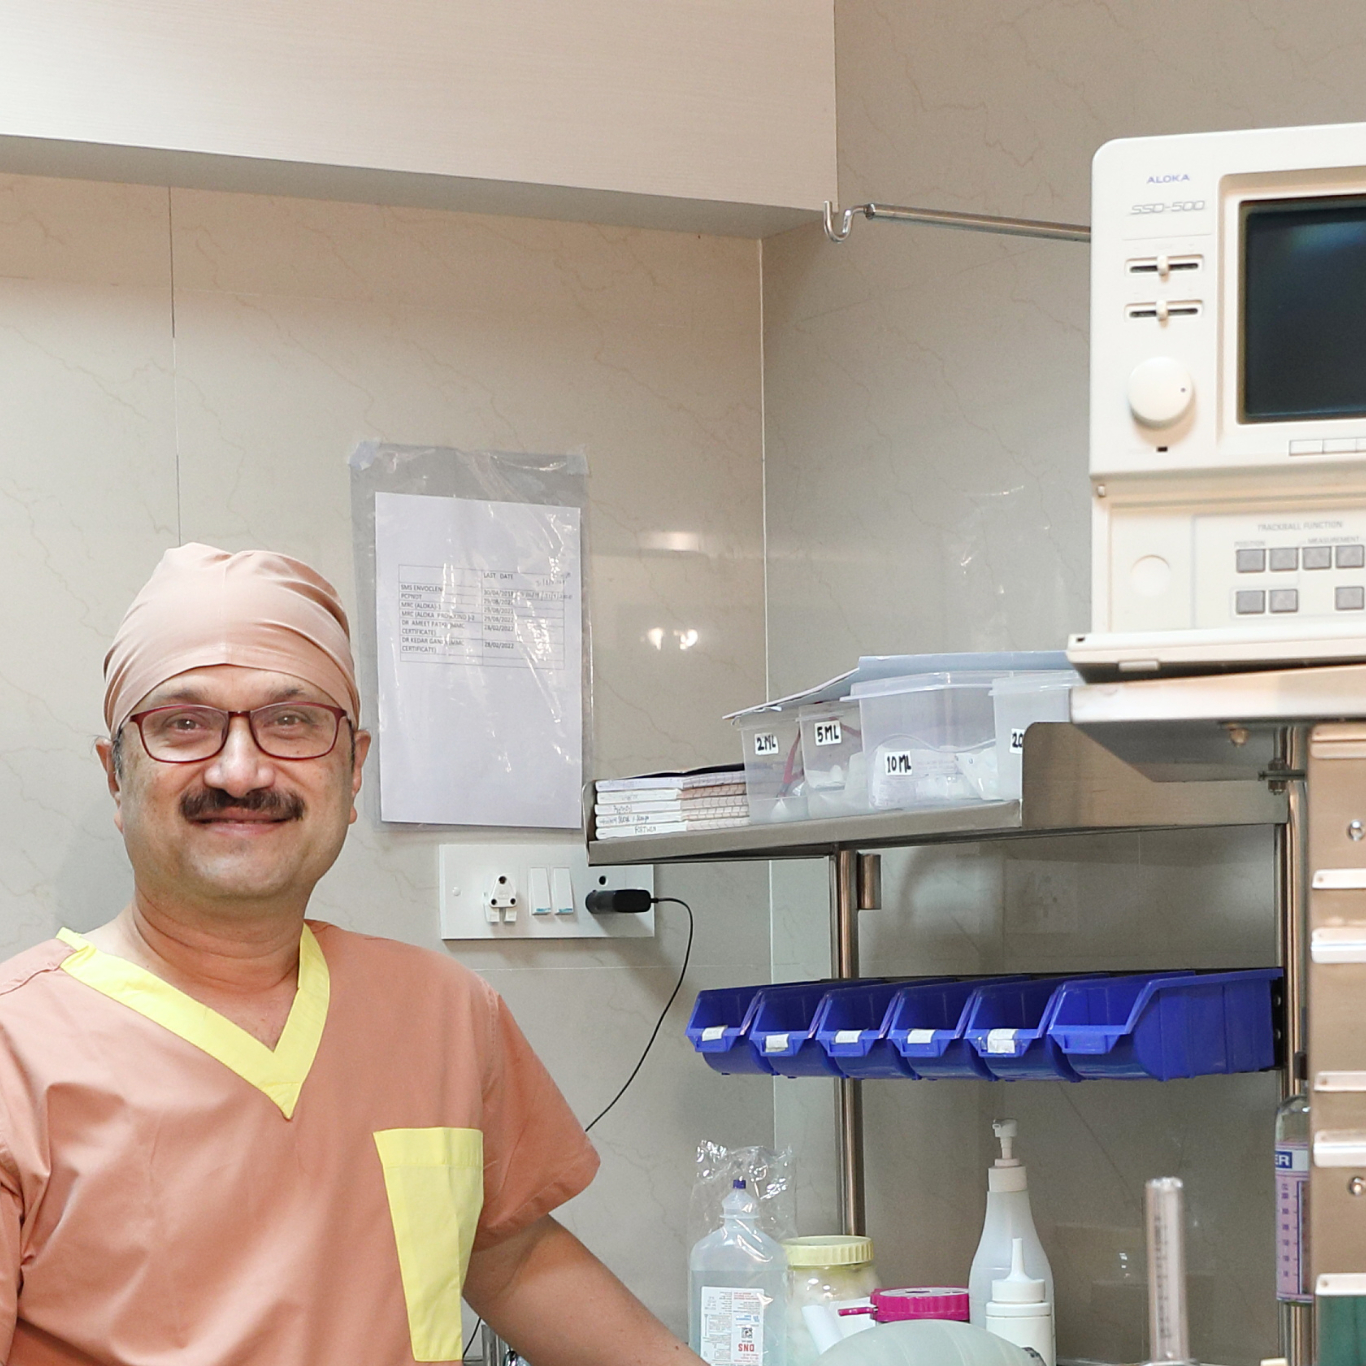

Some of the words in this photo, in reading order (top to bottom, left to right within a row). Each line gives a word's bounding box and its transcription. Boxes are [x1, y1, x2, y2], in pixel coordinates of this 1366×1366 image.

[1146, 174, 1190, 184] ALOKA
[1130, 200, 1205, 215] SSD-500
[500, 573, 514, 581] DATE
[816, 725, 840, 743] 5ML
[756, 735, 777, 751] 2ML
[886, 755, 912, 773] 10ML
[738, 1343, 755, 1352] DNS
